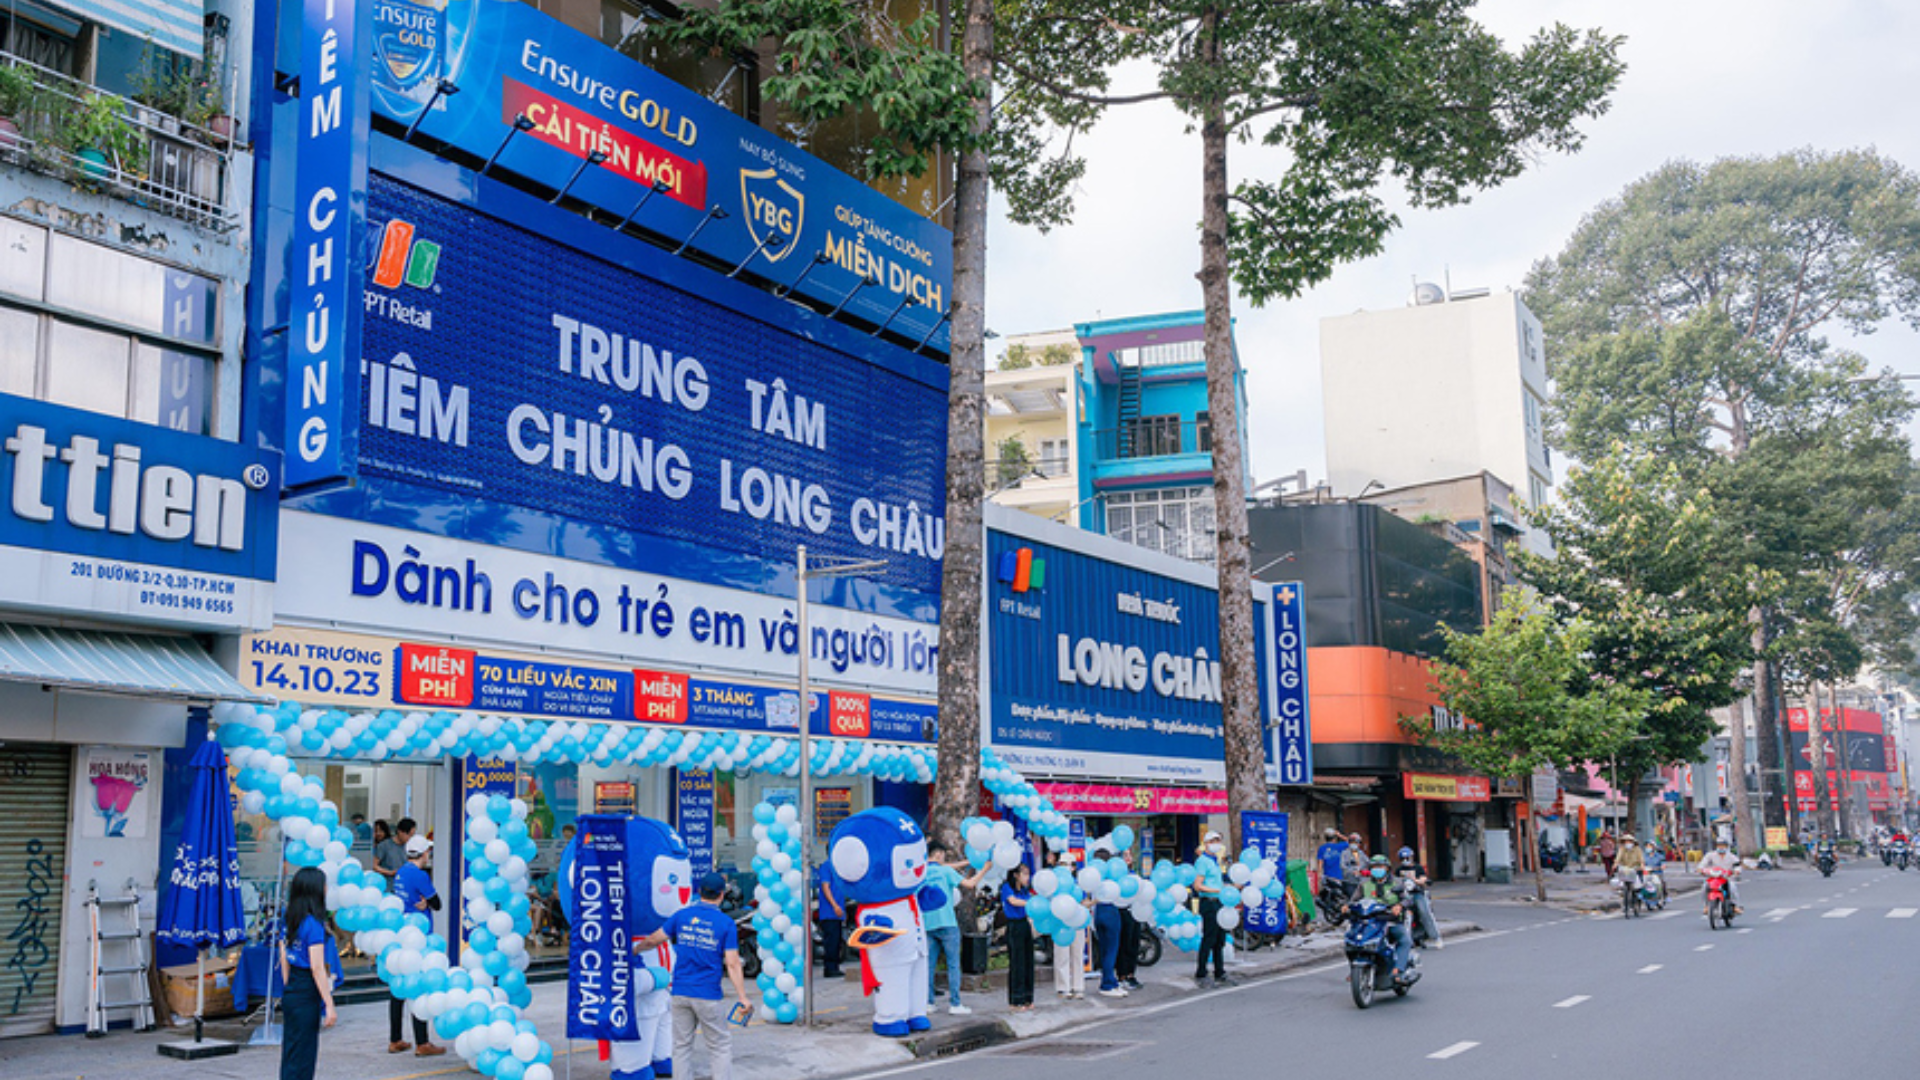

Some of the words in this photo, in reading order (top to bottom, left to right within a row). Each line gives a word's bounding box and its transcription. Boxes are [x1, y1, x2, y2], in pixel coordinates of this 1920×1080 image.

[373, 5, 436, 35] nsure
[399, 29, 436, 50] GOLD
[522, 39, 615, 110] Ensure
[620, 89, 697, 147] GOLD
[527, 102, 571, 144] CẢI
[576, 122, 630, 172] TIẾN
[636, 151, 682, 195] MỚI
[751, 192, 793, 235] YBG
[835, 204, 862, 229] GIÚP
[864, 218, 892, 247] TĂNG
[892, 235, 933, 267] CƯỜNG
[825, 229, 884, 287] MIỄN
[889, 260, 942, 314] DỊCH
[299, 186, 337, 463] CHỦNG
[389, 298, 432, 331] Retail
[551, 312, 711, 412] TRUNG
[745, 378, 826, 451] TÂM
[360, 351, 470, 448] IÊM
[506, 403, 693, 500] CHỦNG
[720, 458, 832, 534] LONG
[850, 496, 944, 560] CHÂU
[71, 561, 93, 578] 201
[97, 564, 140, 584] ĐƯỜNG
[181, 595, 202, 611] 949
[205, 598, 234, 614] 6565
[351, 539, 492, 614] Dành
[512, 571, 600, 627] cho
[617, 582, 675, 638] trẻ
[689, 606, 746, 649] em
[760, 608, 799, 656] và
[810, 622, 894, 674] người
[251, 638, 301, 659] KHAI
[305, 643, 383, 667] TRƯƠNG
[410, 648, 466, 677] MIỄN
[1057, 633, 1148, 693] LONG
[1278, 610, 1300, 690] LONG
[251, 660, 381, 697] 14.10.23
[418, 677, 457, 699] PHÍ
[480, 664, 502, 682] 70
[551, 667, 585, 690] VẮC
[589, 675, 617, 693] XIN
[640, 675, 683, 700] MIỄN
[693, 687, 702, 703] 3
[705, 686, 754, 707] THÁNG
[647, 701, 677, 720] PHÍ
[693, 704, 731, 717] VITAMIN
[834, 695, 866, 713] 100%
[836, 711, 865, 731] QUÀ
[1281, 697, 1302, 783] CHÂU
[579, 865, 602, 943] LONG
[607, 861, 625, 921] TIÊM
[578, 950, 606, 1026] CHÂU
[609, 927, 630, 1028] CHỦNG
